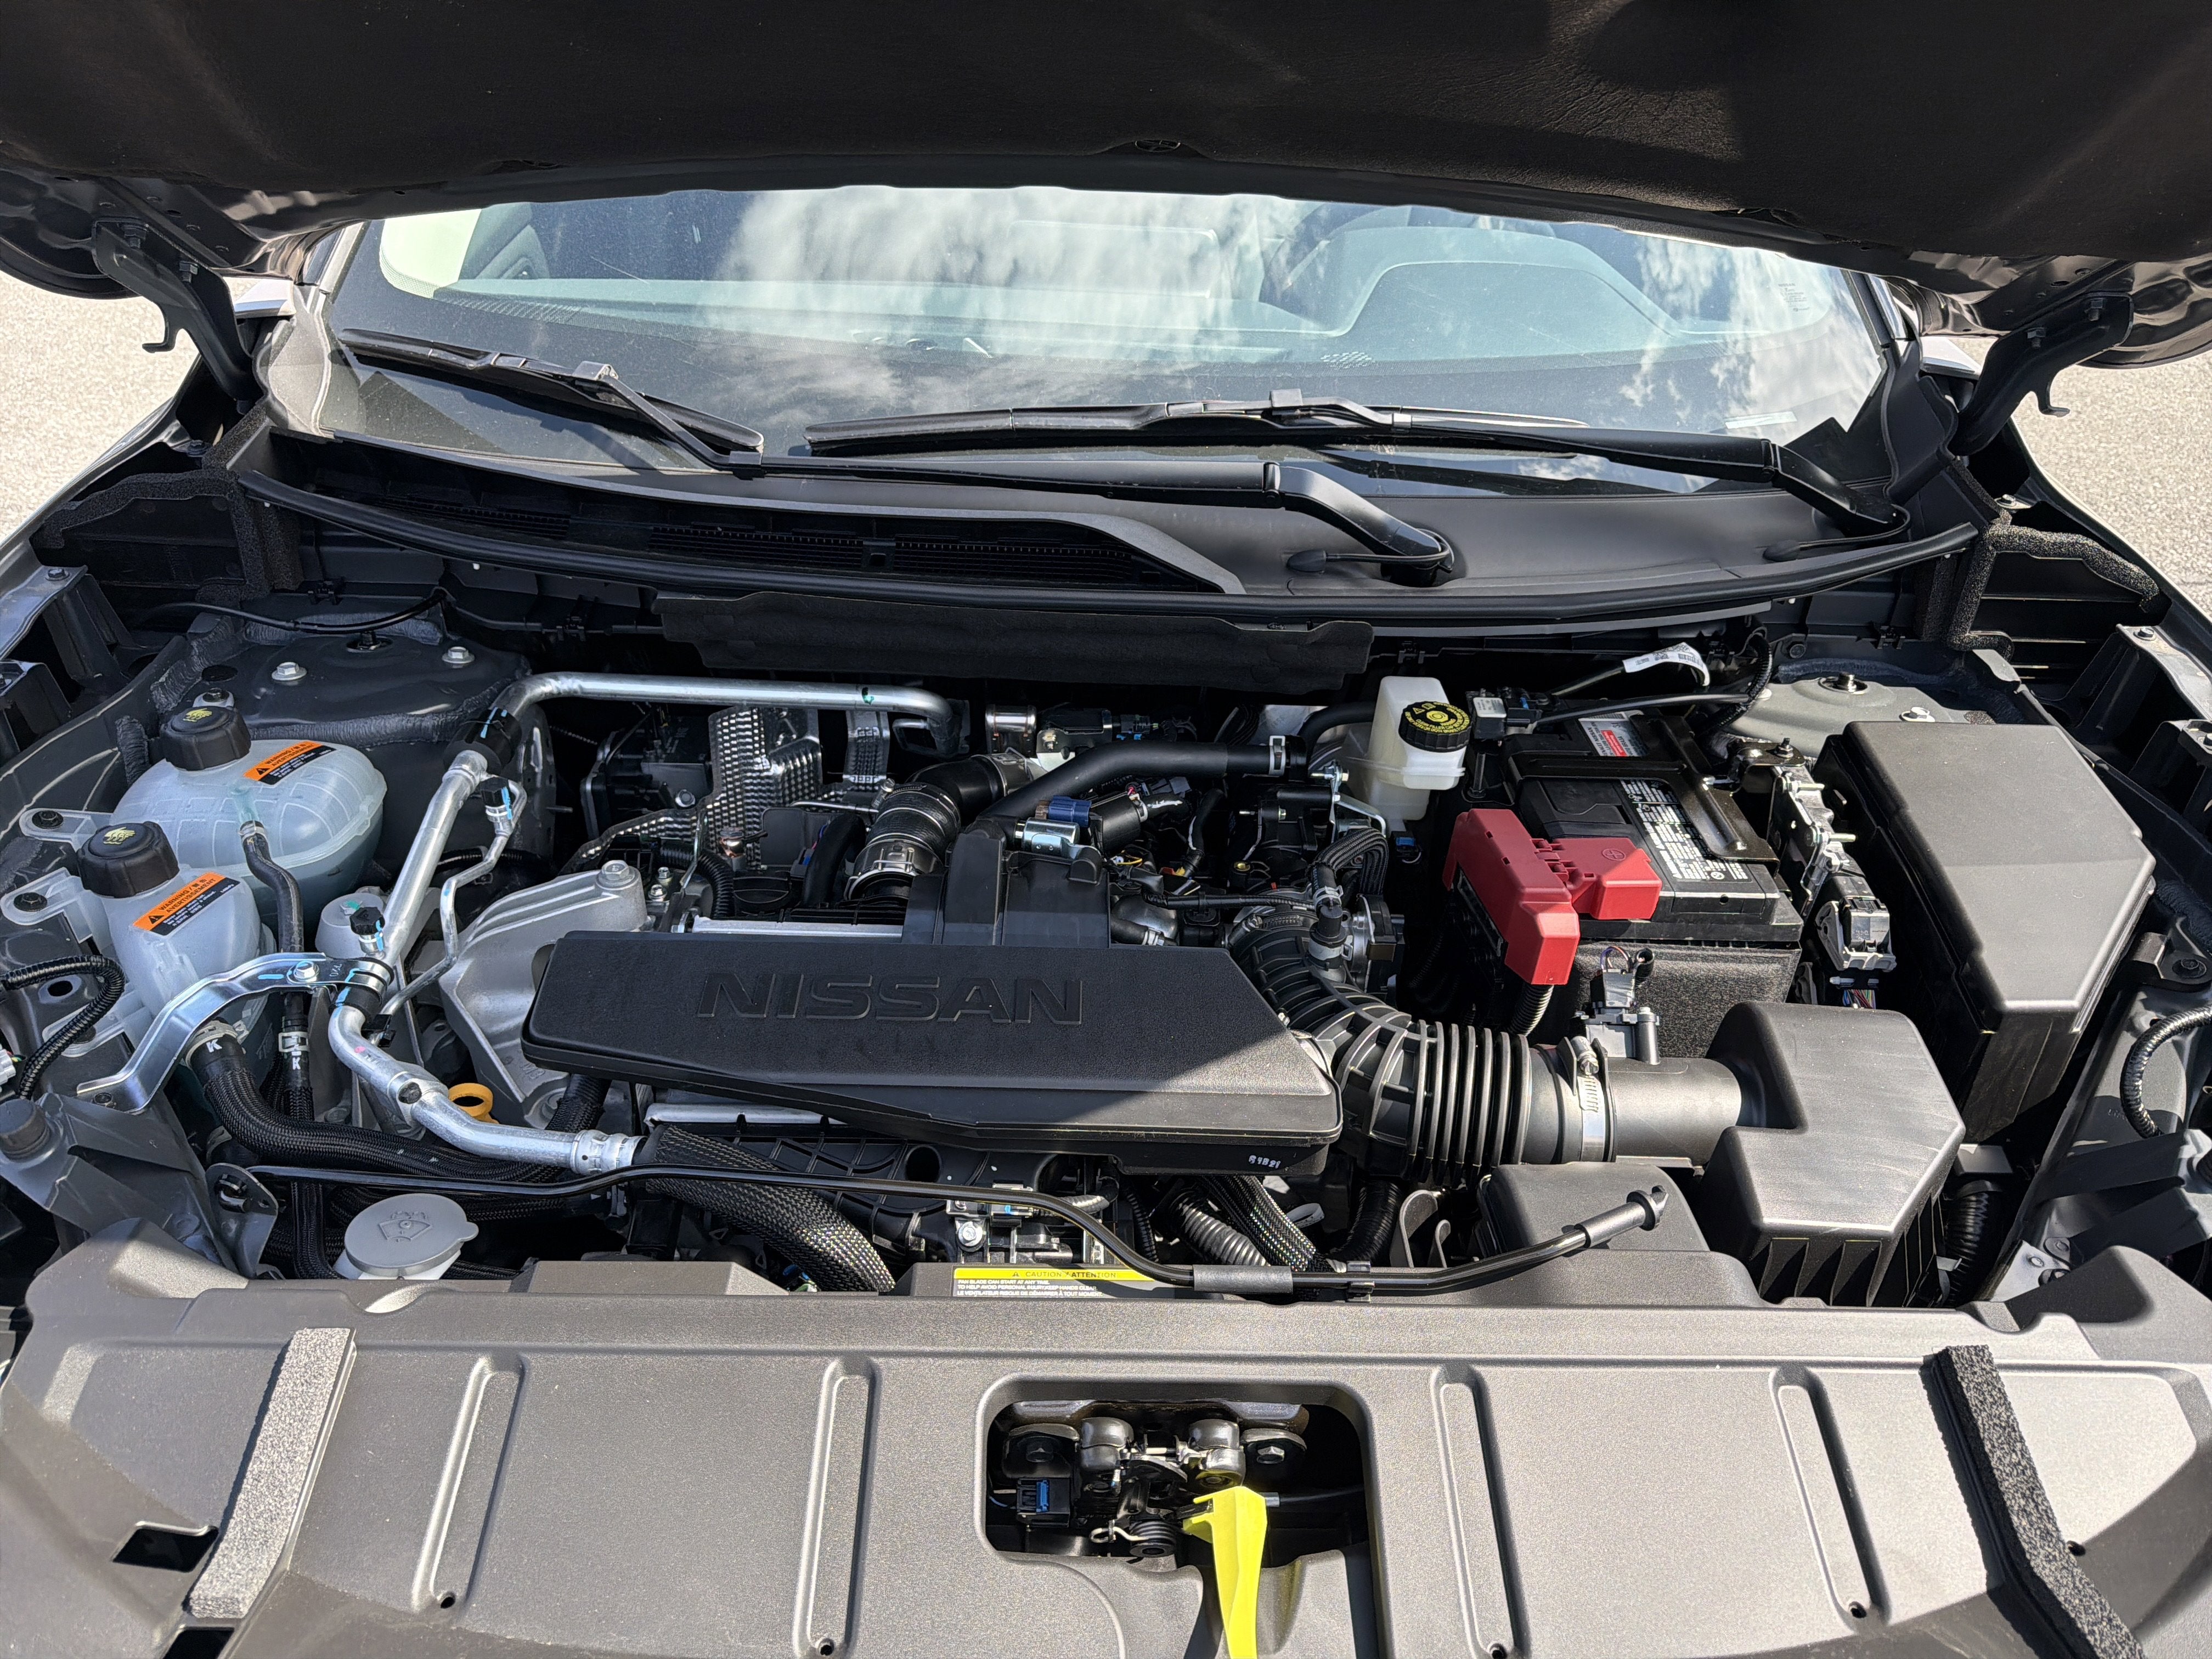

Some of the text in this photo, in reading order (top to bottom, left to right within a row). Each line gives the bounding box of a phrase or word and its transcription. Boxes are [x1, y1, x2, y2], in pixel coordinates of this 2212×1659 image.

[158, 889, 189, 911] WARNING
[166, 878, 217, 913] AVERTISSEMENT
[697, 973, 1083, 1025] NISSAN
[206, 1039, 222, 1053] K
[292, 1057, 301, 1070] K
